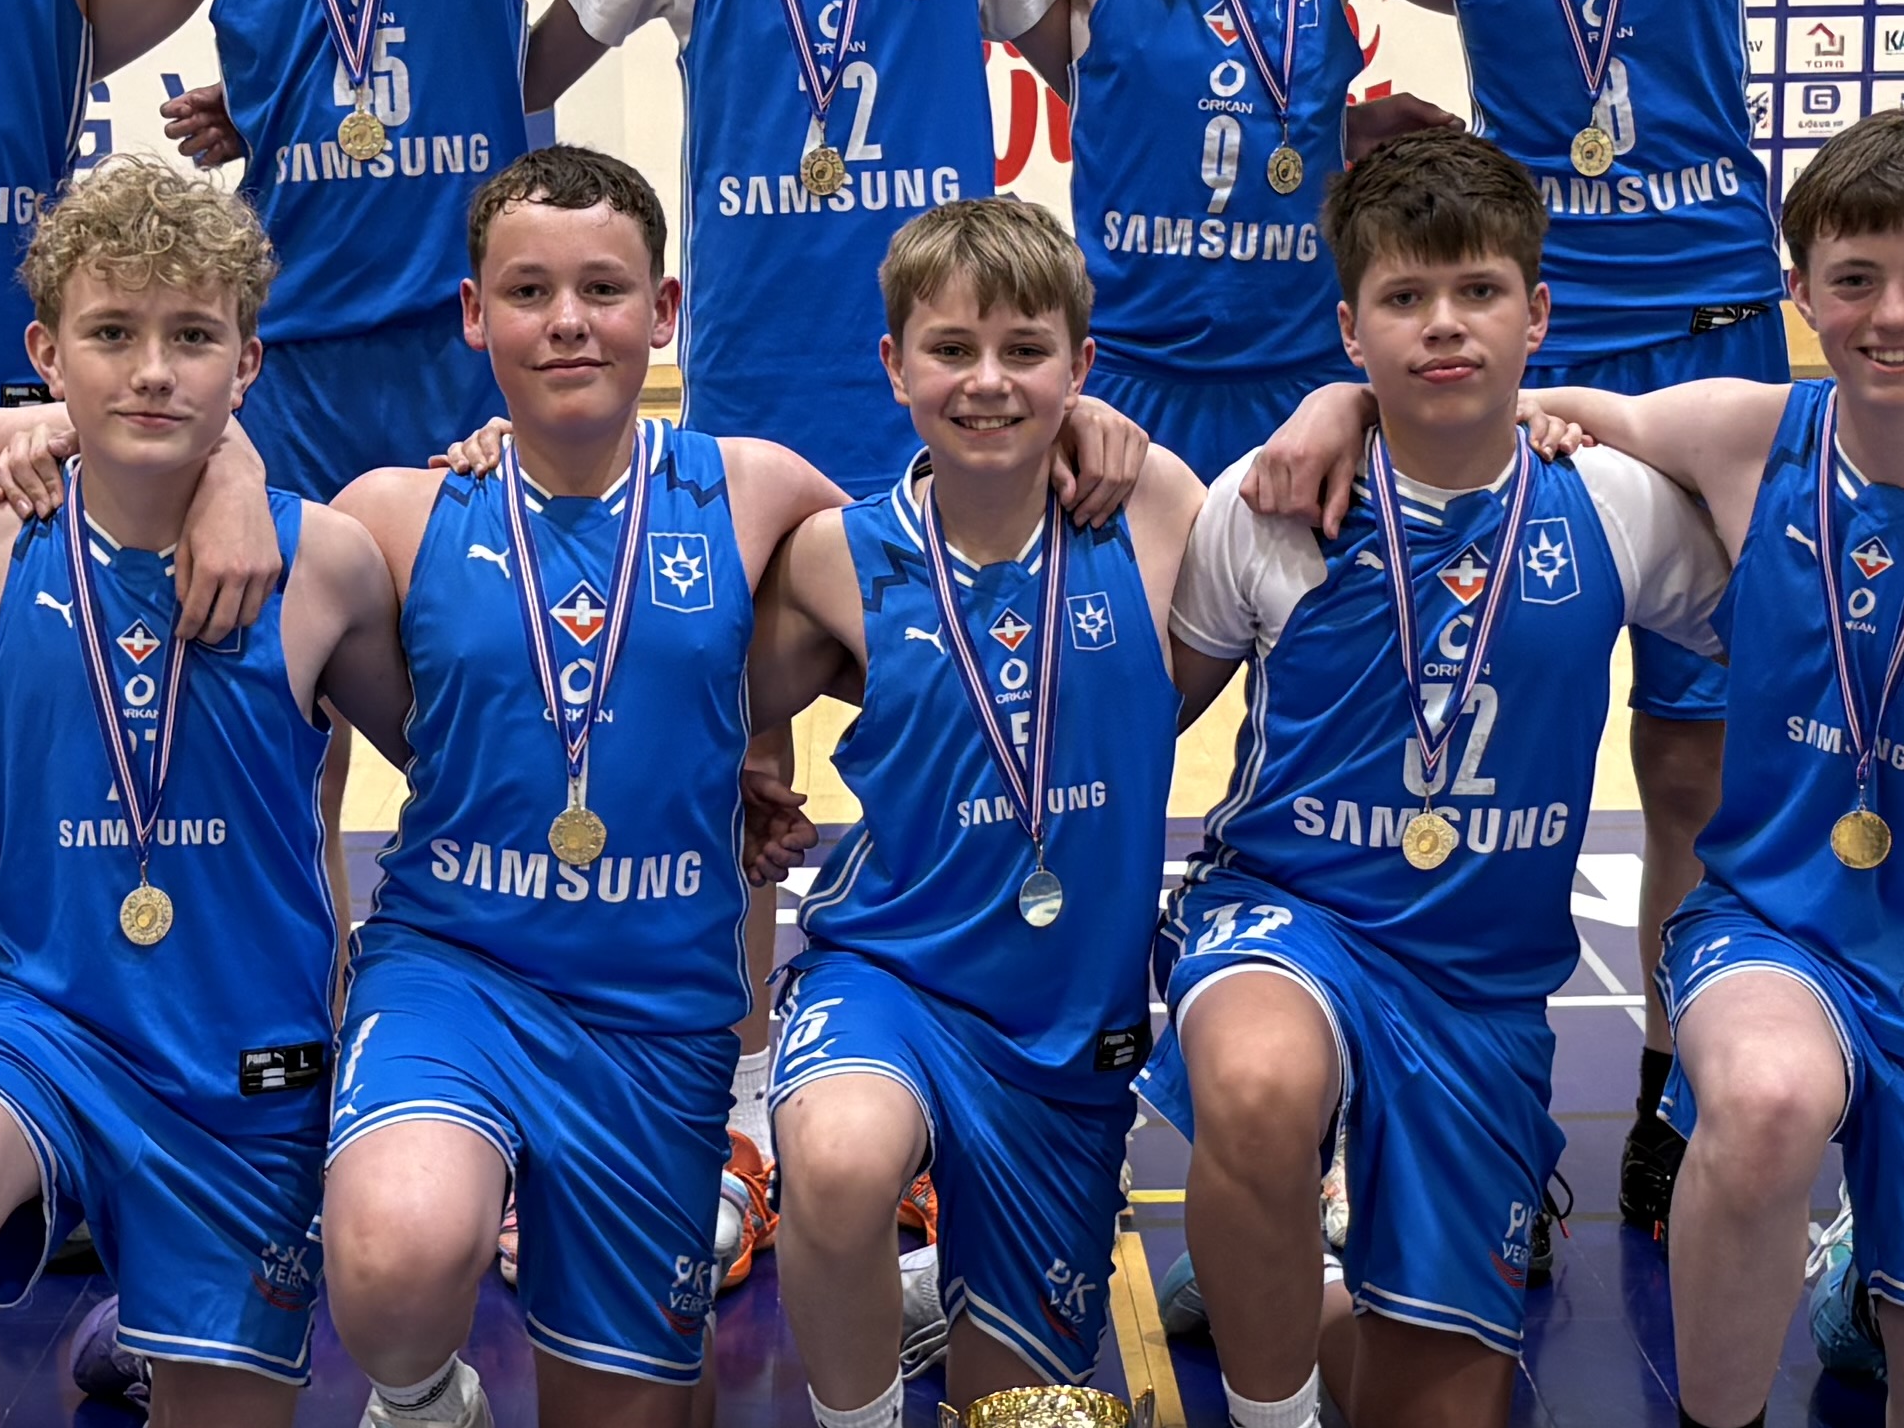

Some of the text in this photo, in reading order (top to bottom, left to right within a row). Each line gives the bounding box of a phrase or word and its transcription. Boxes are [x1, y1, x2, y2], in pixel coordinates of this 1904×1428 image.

[1805, 59, 1845, 69] TORG
[1198, 98, 1253, 114] ORKAN
[1200, 115, 1242, 214] 9
[1542, 156, 1740, 217] AMSUNG
[718, 165, 961, 217] SAMSUNG
[1103, 209, 1319, 262] SAMSUNG
[957, 779, 1108, 828] SAMUNG
[429, 838, 701, 904] SAMSUNG
[299, 1050, 309, 1069] L
